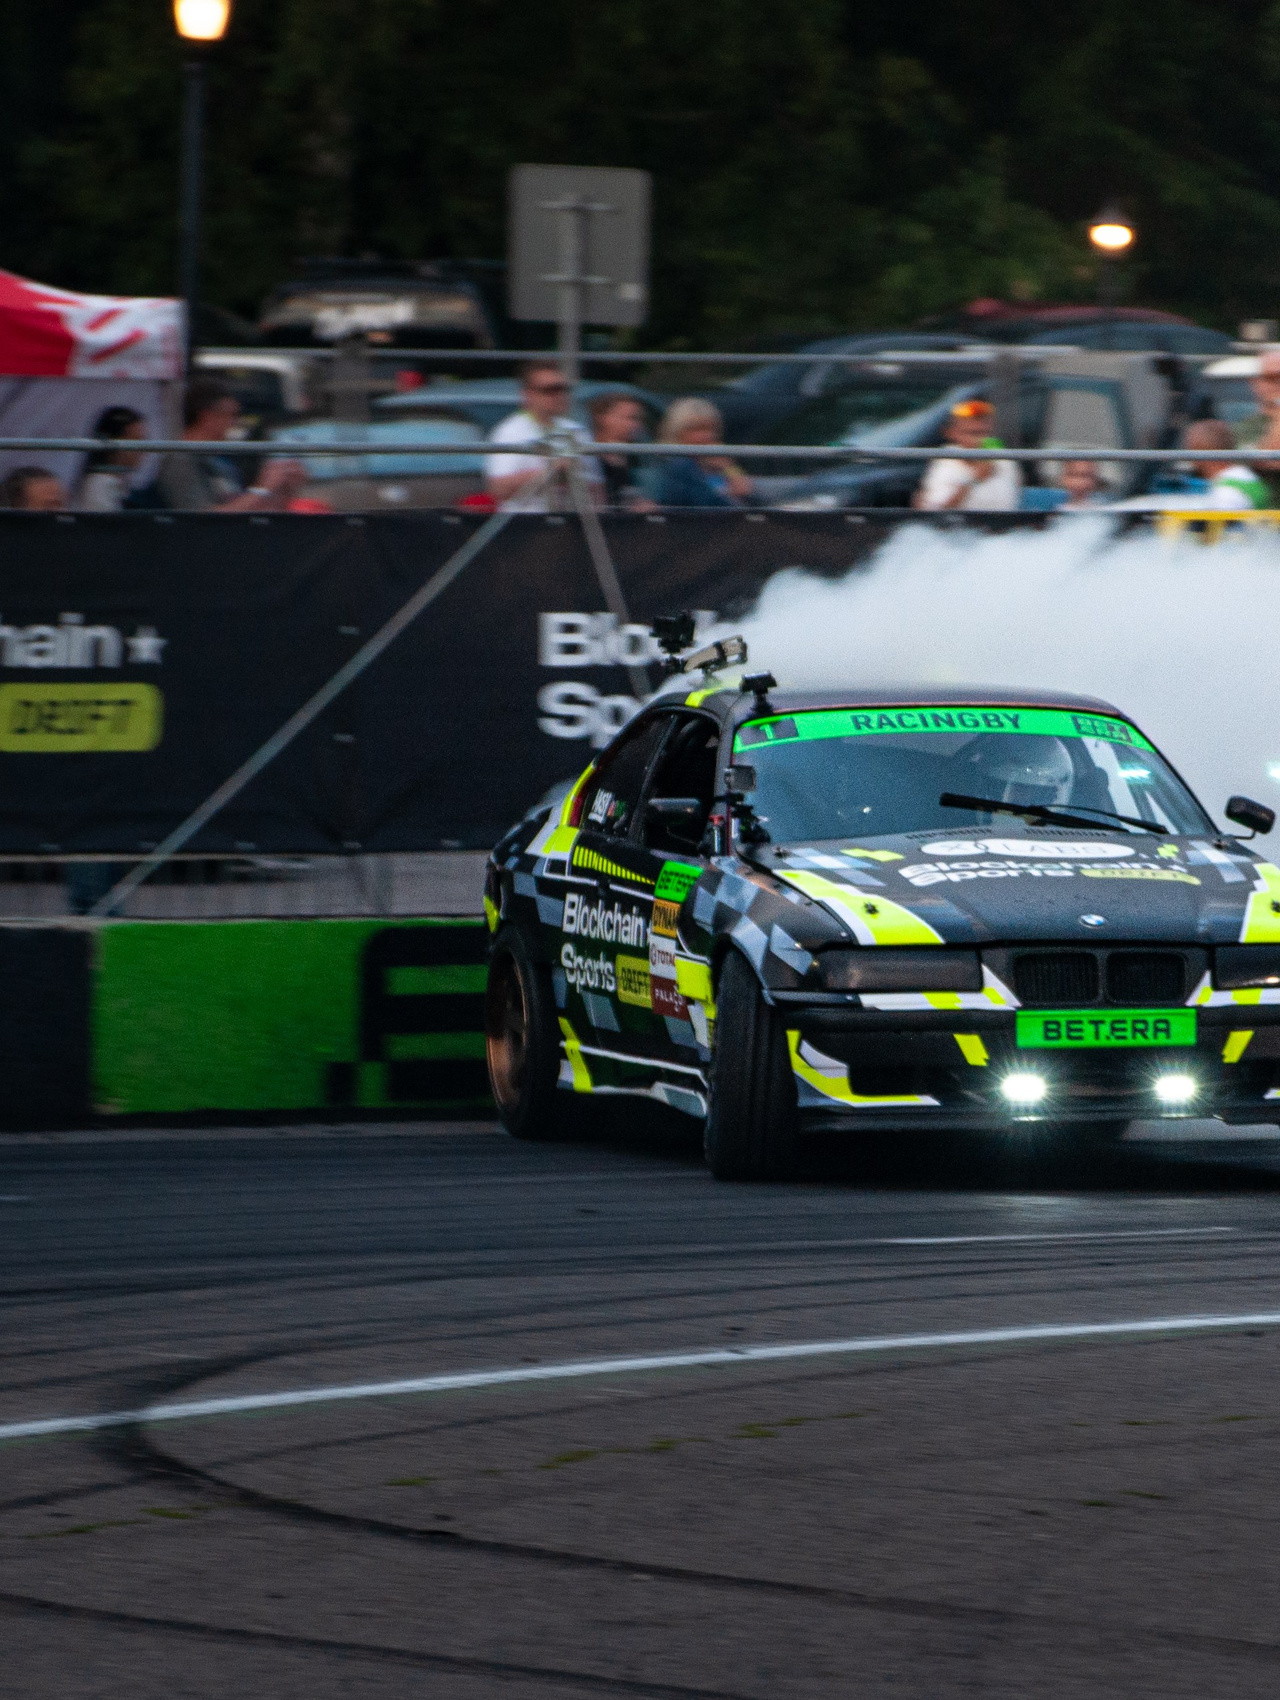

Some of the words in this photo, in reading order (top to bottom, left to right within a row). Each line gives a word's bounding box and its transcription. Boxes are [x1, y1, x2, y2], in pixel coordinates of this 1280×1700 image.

[537, 612, 700, 666] Blo
[850, 712, 1020, 731] RACINGBY
[563, 893, 645, 948] Blockchain
[561, 943, 617, 994] Sports
[1043, 1018, 1171, 1041] BET.ERA
